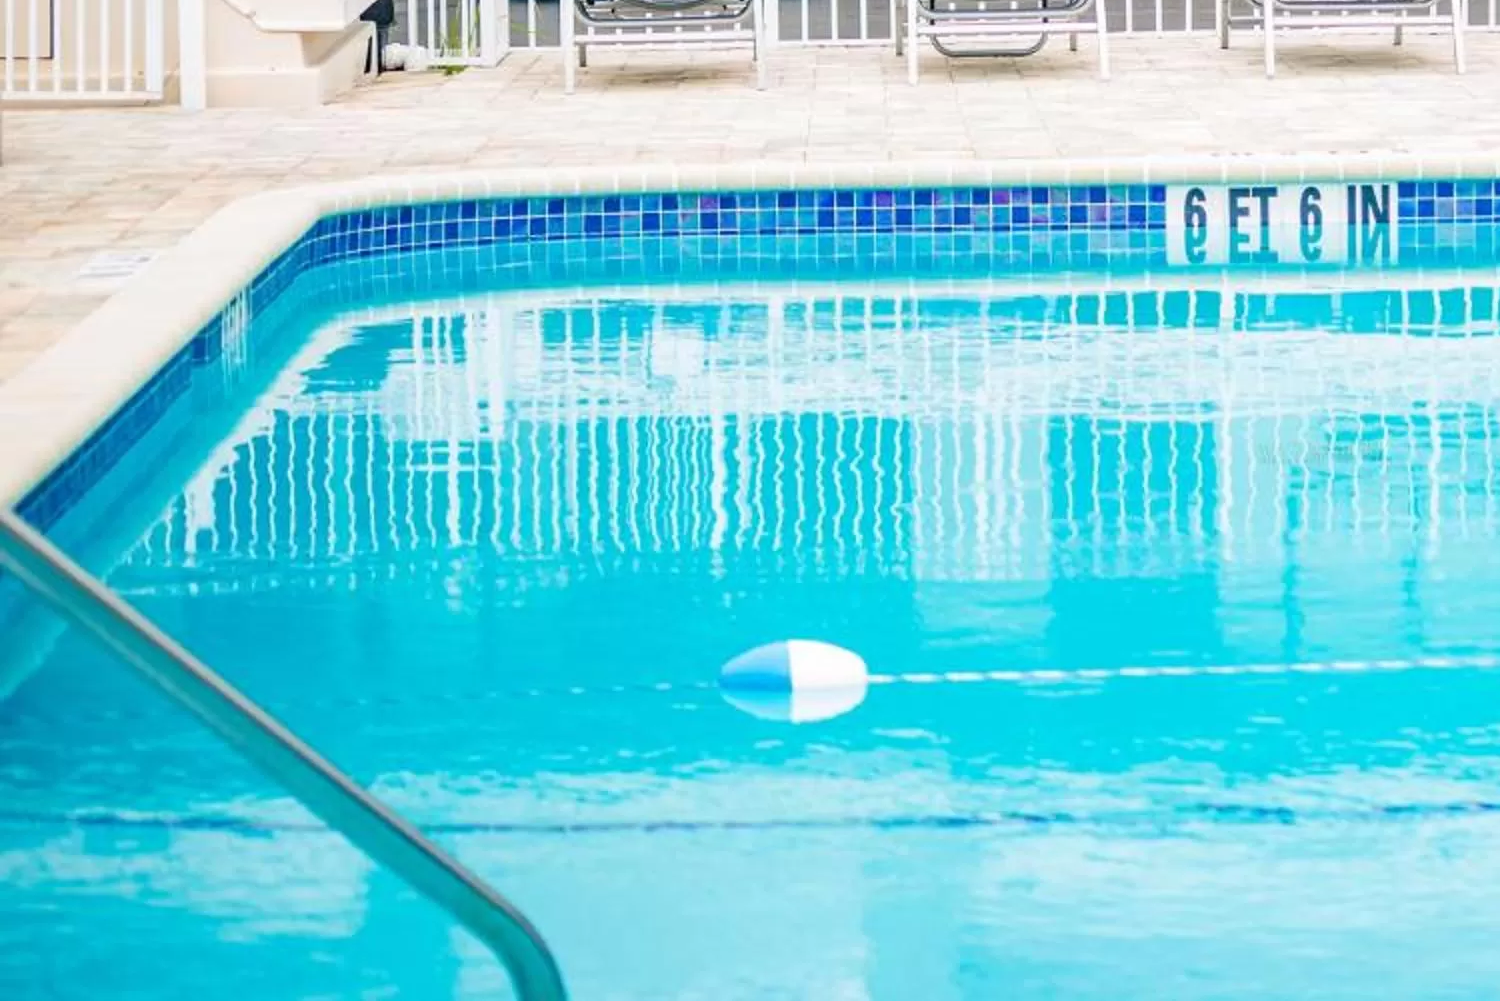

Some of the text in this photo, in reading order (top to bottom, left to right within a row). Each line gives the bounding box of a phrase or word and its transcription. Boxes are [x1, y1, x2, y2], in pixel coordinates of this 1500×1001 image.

[1184, 185, 1390, 227] 6 FT 6 IN
